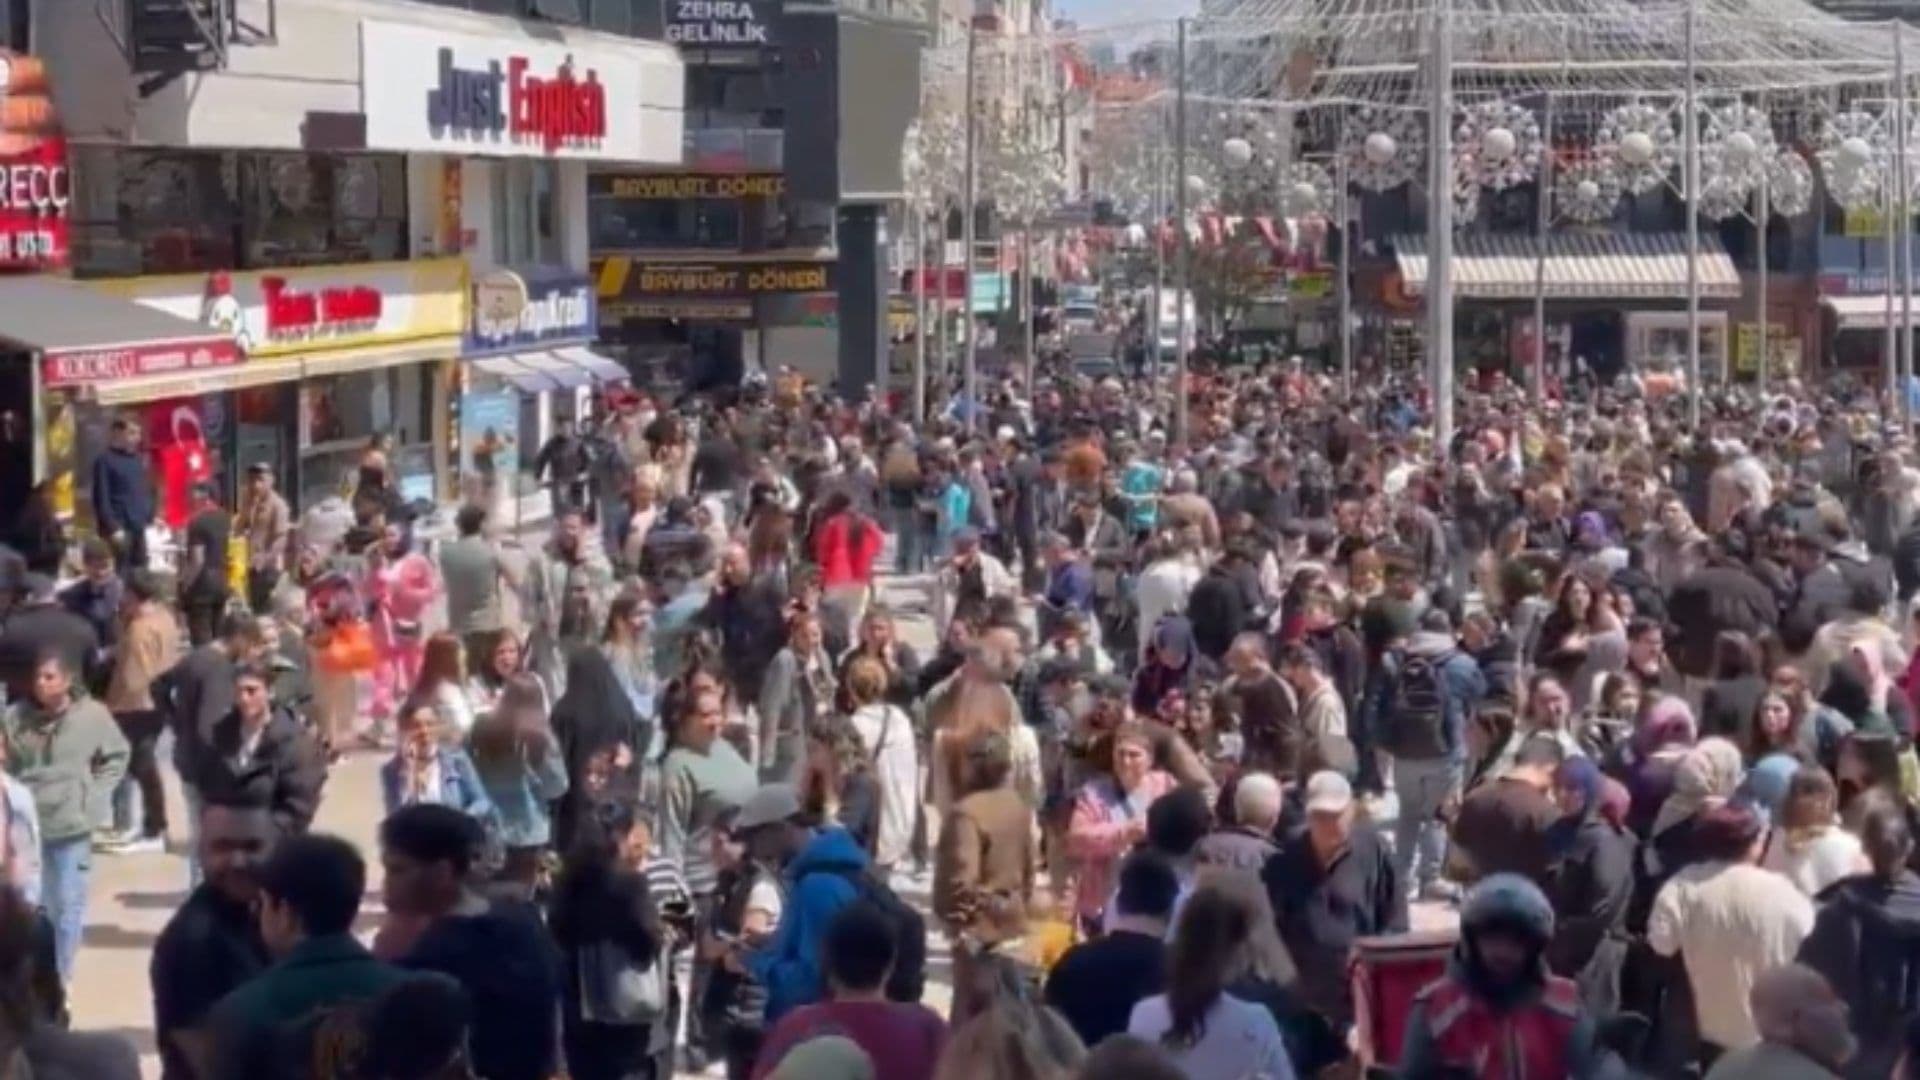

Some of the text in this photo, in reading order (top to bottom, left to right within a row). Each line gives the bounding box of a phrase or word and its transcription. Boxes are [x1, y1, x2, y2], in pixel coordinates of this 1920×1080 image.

[677, 0, 754, 20] ZEHRA
[664, 20, 767, 43] GELİNLİK
[428, 46, 607, 152] Just English
[641, 264, 828, 290] BAYBURT DÖNERİ
